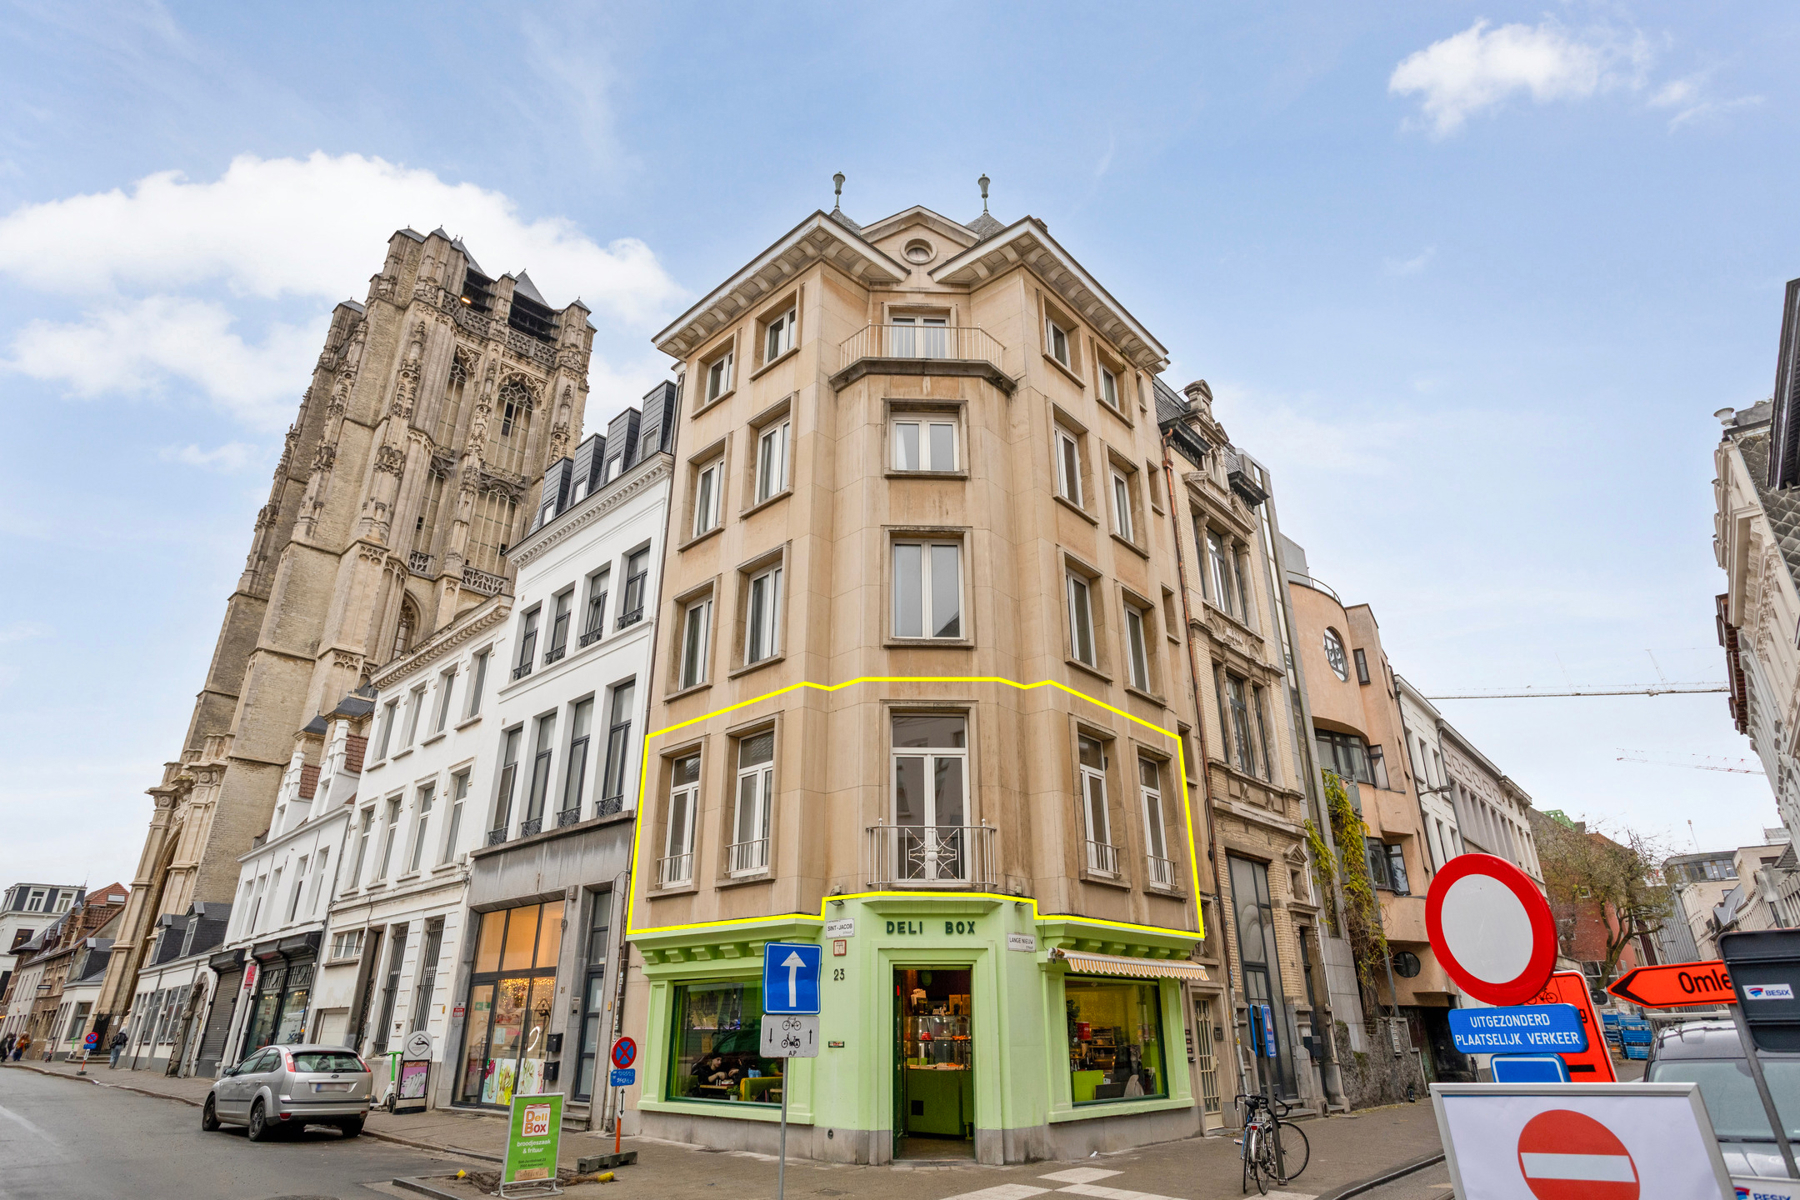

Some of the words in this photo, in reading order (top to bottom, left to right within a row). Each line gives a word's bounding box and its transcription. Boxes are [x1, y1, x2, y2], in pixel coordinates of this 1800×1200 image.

[886, 921, 923, 935] DELI
[945, 921, 976, 934] BOX
[833, 968, 845, 981] 23
[1470, 1013, 1551, 1028] UITGEZONDERD
[1455, 1033, 1523, 1046] PLAATSELIJK
[1526, 1031, 1581, 1045] VERKEER
[526, 1110, 548, 1123] Deli
[524, 1122, 547, 1134] Box
